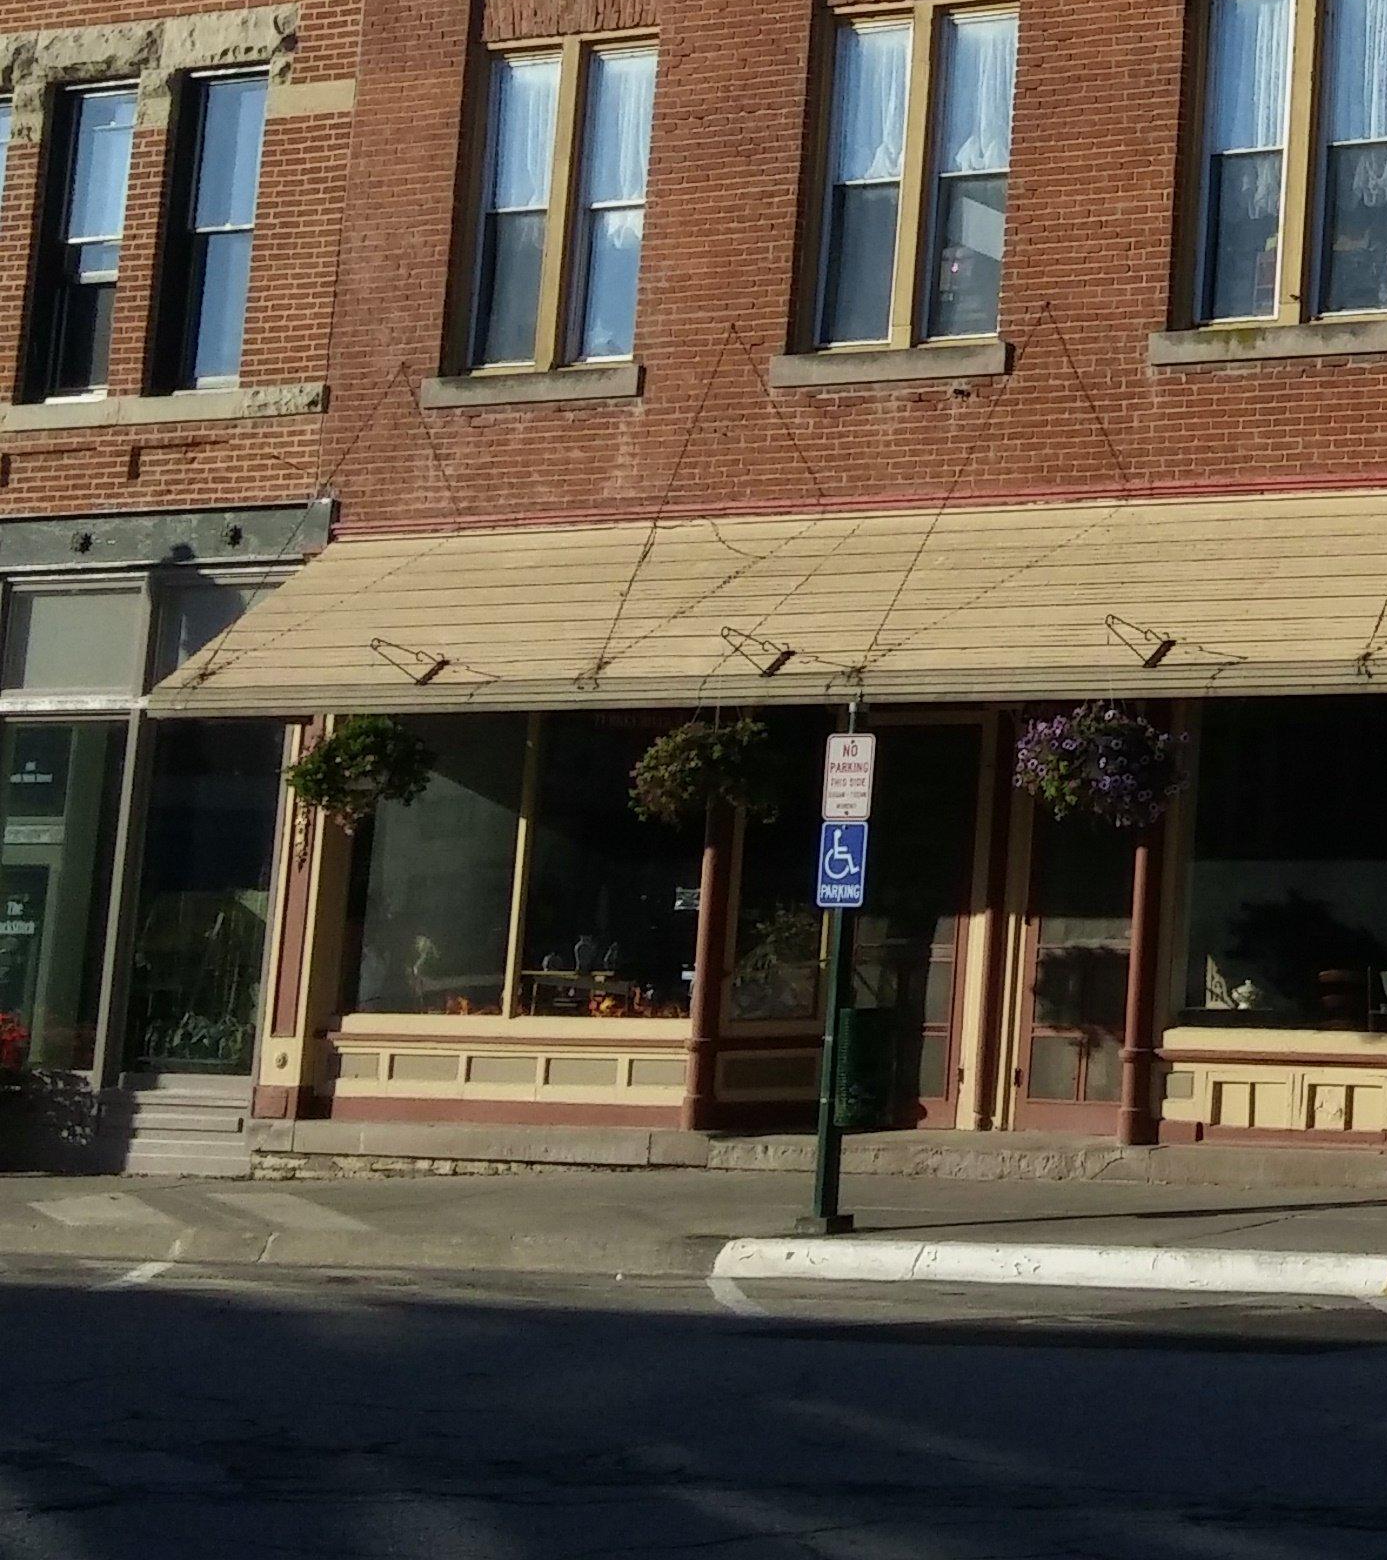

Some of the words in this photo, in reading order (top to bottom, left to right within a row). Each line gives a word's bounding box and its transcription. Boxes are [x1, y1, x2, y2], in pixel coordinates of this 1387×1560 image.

[842, 744, 858, 757] NO
[830, 762, 869, 774] PARKING
[820, 883, 860, 900] PARKING
